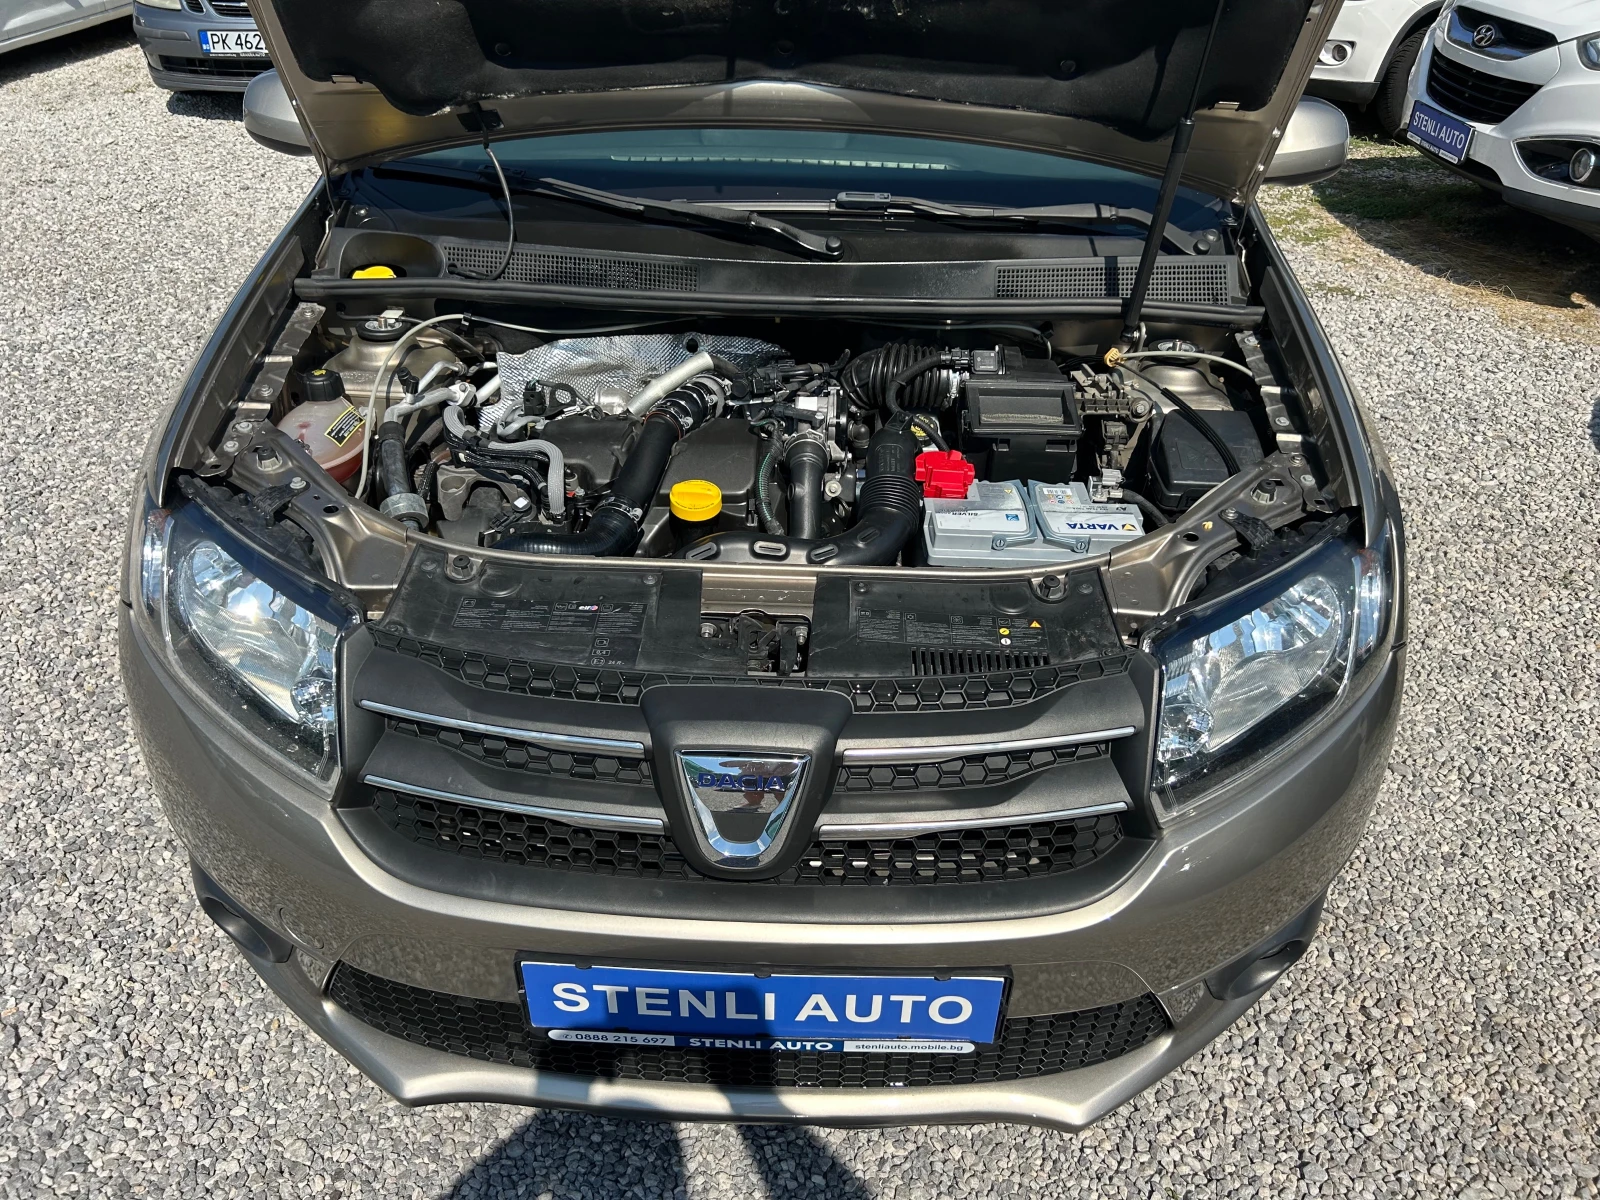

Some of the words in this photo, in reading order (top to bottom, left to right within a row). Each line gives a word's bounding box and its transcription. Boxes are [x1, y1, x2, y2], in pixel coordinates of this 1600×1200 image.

[211, 34, 230, 50] PK
[235, 33, 267, 50] 462
[1413, 112, 1440, 137] STENLI
[1439, 126, 1464, 149] AUTO
[1066, 522, 1119, 531] VARTA
[697, 772, 785, 791] DACIA
[552, 982, 775, 1021] STENLI
[794, 994, 973, 1025] AUTO
[575, 1033, 609, 1041] 0888
[613, 1035, 638, 1043] 215
[642, 1036, 667, 1044] 697
[689, 1038, 762, 1049] STENLI
[770, 1041, 834, 1051] AUTO
[855, 1043, 964, 1052] stenliauto.mobile.bg
